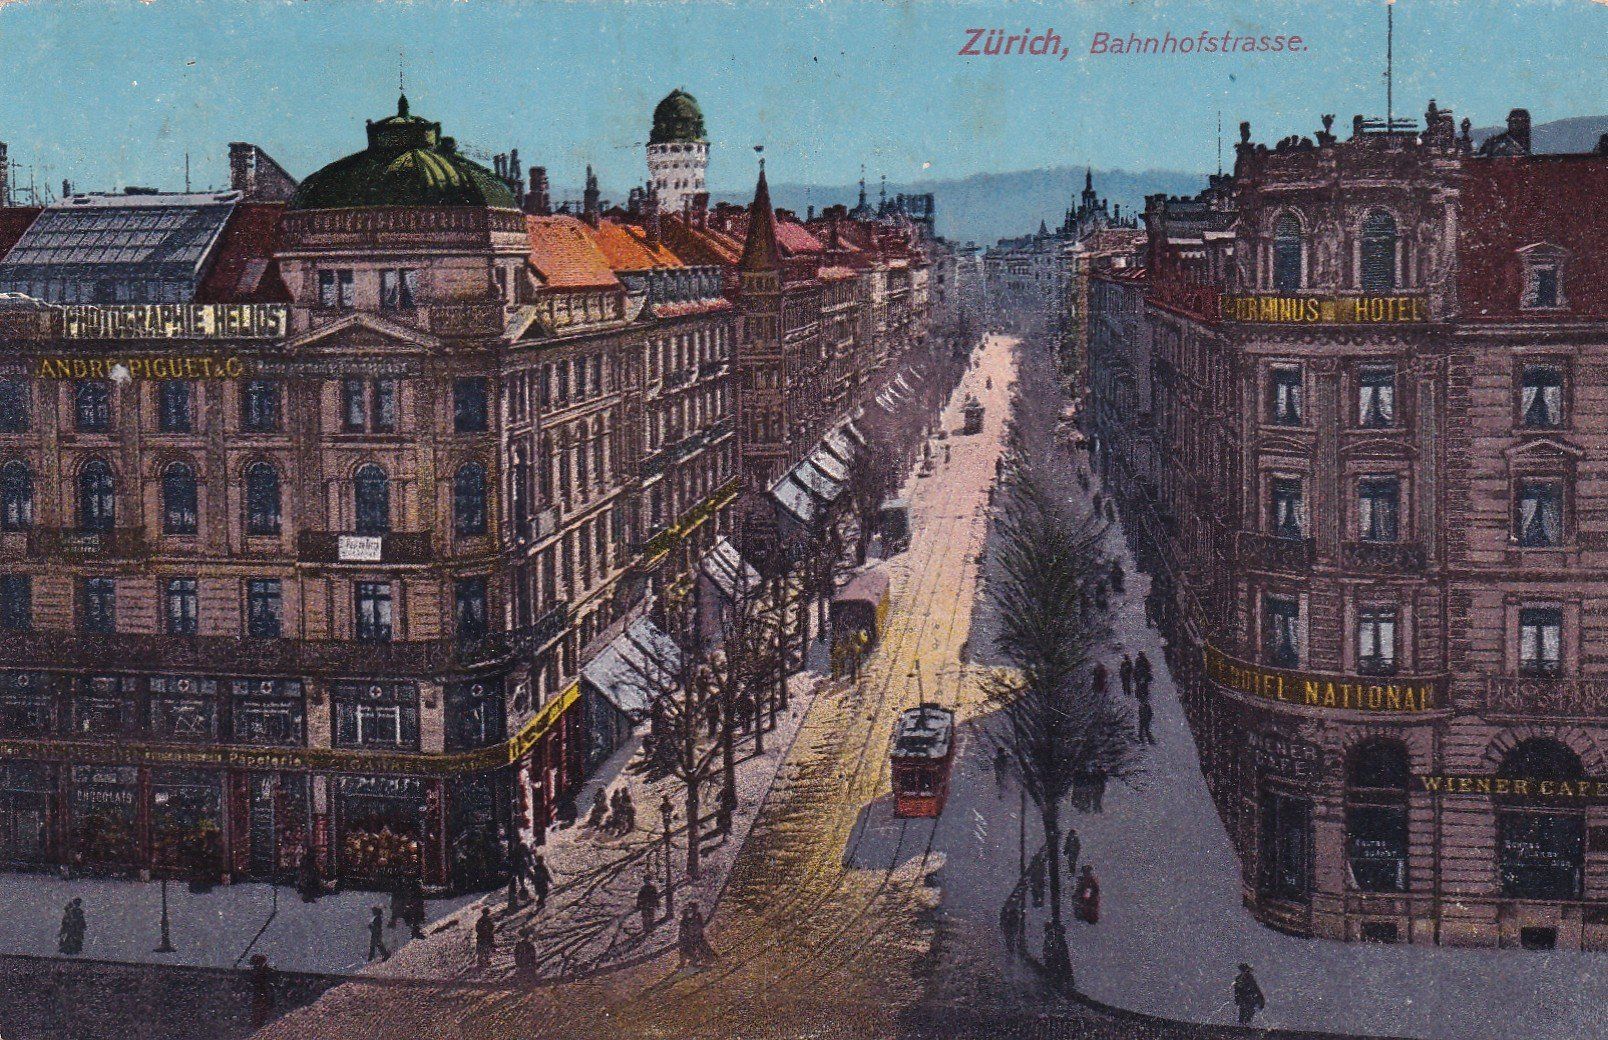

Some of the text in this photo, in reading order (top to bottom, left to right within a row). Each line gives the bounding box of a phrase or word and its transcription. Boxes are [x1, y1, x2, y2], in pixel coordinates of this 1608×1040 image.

[1354, 297, 1422, 321] HOTEL
[129, 357, 212, 378] PIGUET
[1420, 776, 1529, 795] WIENER
